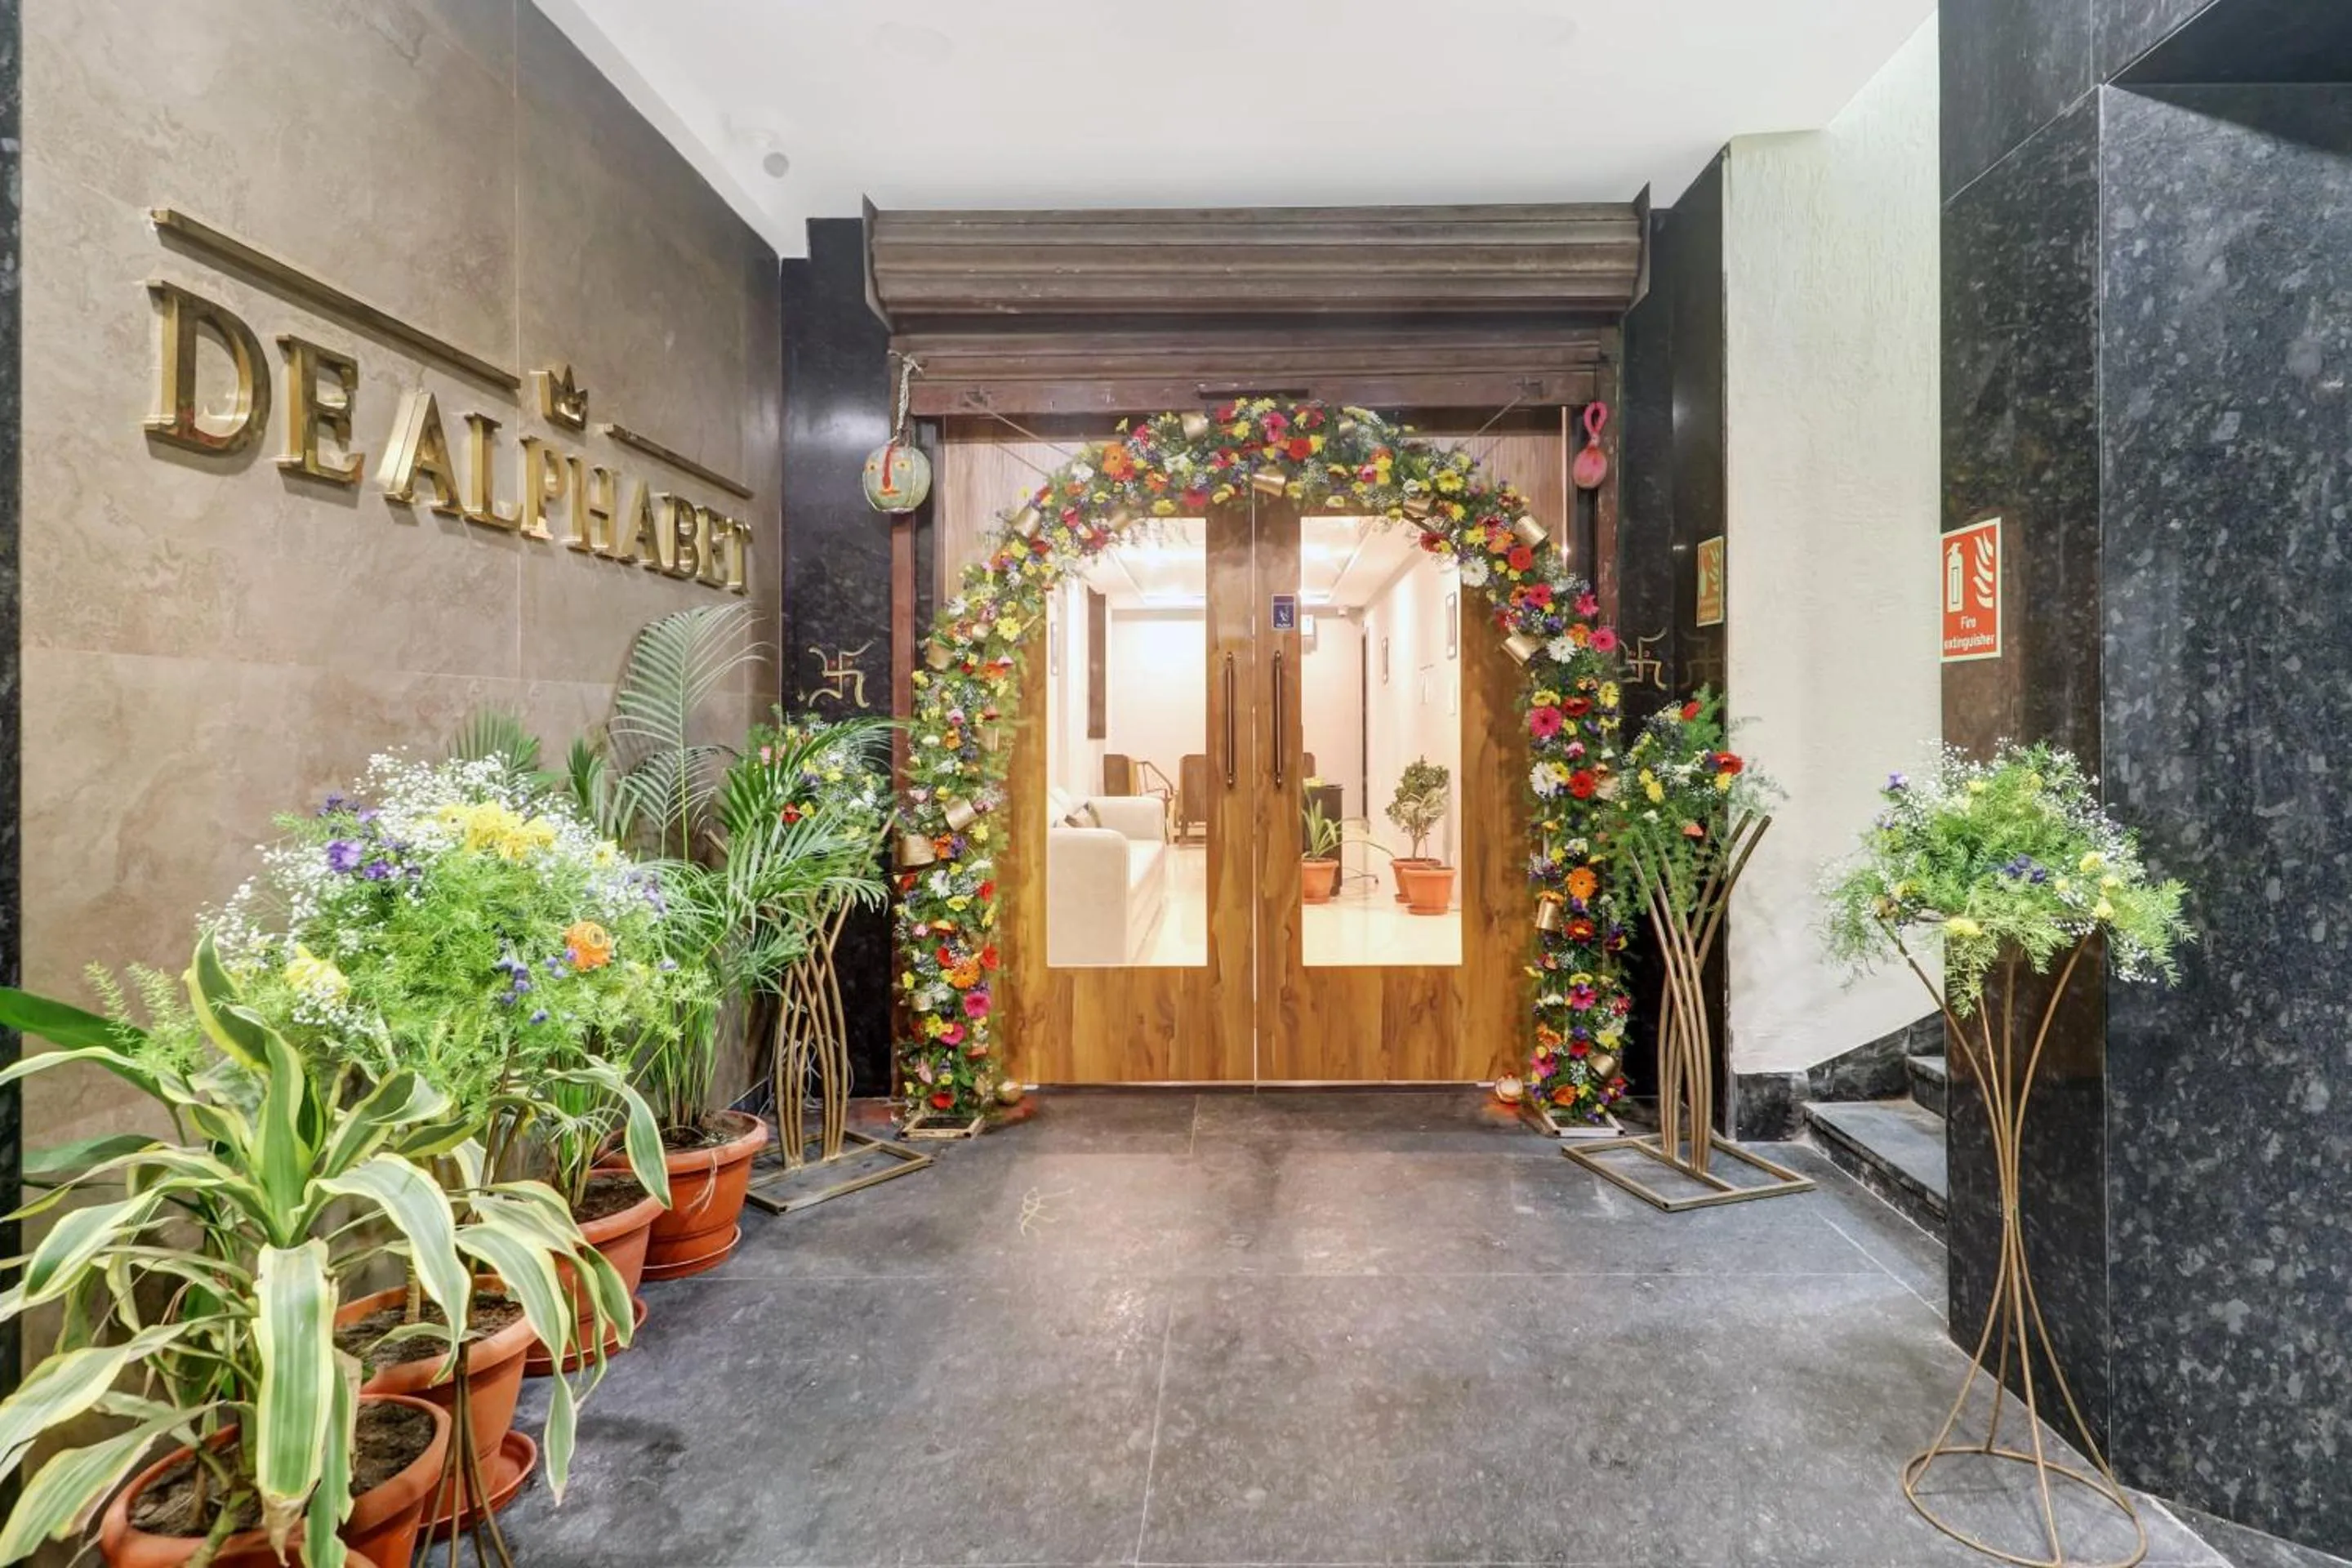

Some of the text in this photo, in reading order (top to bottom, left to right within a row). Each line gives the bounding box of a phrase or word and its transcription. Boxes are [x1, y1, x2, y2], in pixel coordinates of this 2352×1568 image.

[145, 279, 753, 595] DE ALPHABET
[1960, 616, 1977, 629] Fire
